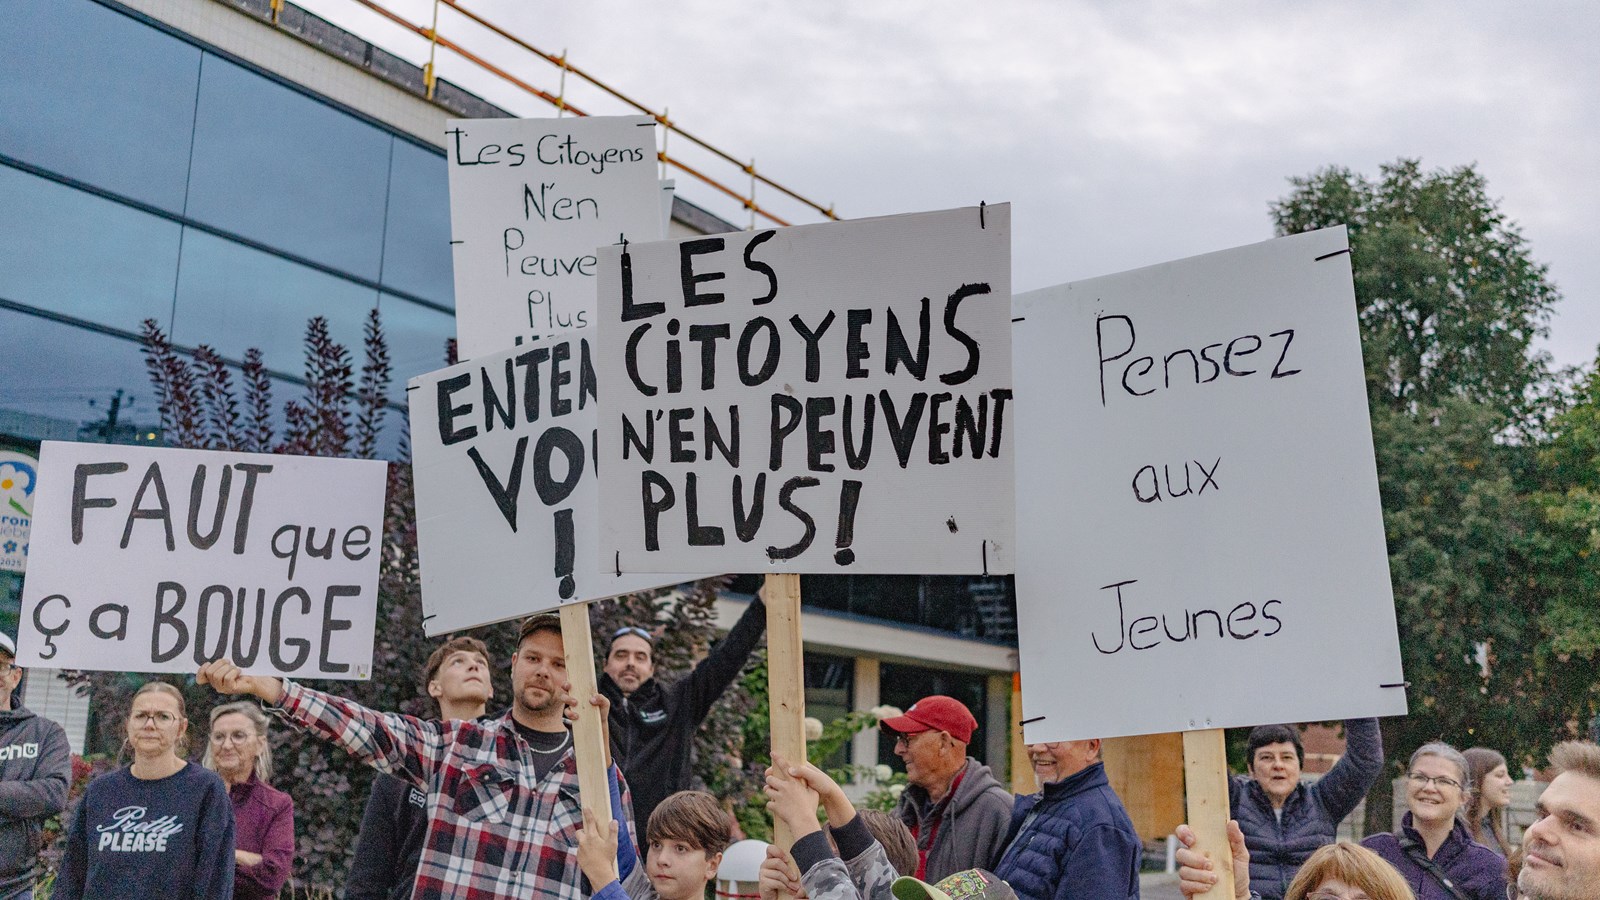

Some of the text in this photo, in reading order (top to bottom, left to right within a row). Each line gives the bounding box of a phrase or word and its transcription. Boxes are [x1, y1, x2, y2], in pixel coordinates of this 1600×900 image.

[456, 128, 644, 175] Les Citoyens
[523, 182, 600, 223] N'en
[503, 227, 598, 278] Peuve
[620, 229, 779, 323] LES
[527, 289, 589, 329] Plus
[1096, 314, 1303, 407] Pensez
[621, 388, 1013, 473] N'EN PEUVENT
[466, 425, 599, 534] VO
[1131, 455, 1222, 504] aux
[71, 460, 373, 582] FAUT que
[552, 508, 576, 600] !
[150, 581, 362, 673] BOUGE
[1091, 579, 1283, 655] Jeunes
[98, 831, 169, 853] PLEASE
